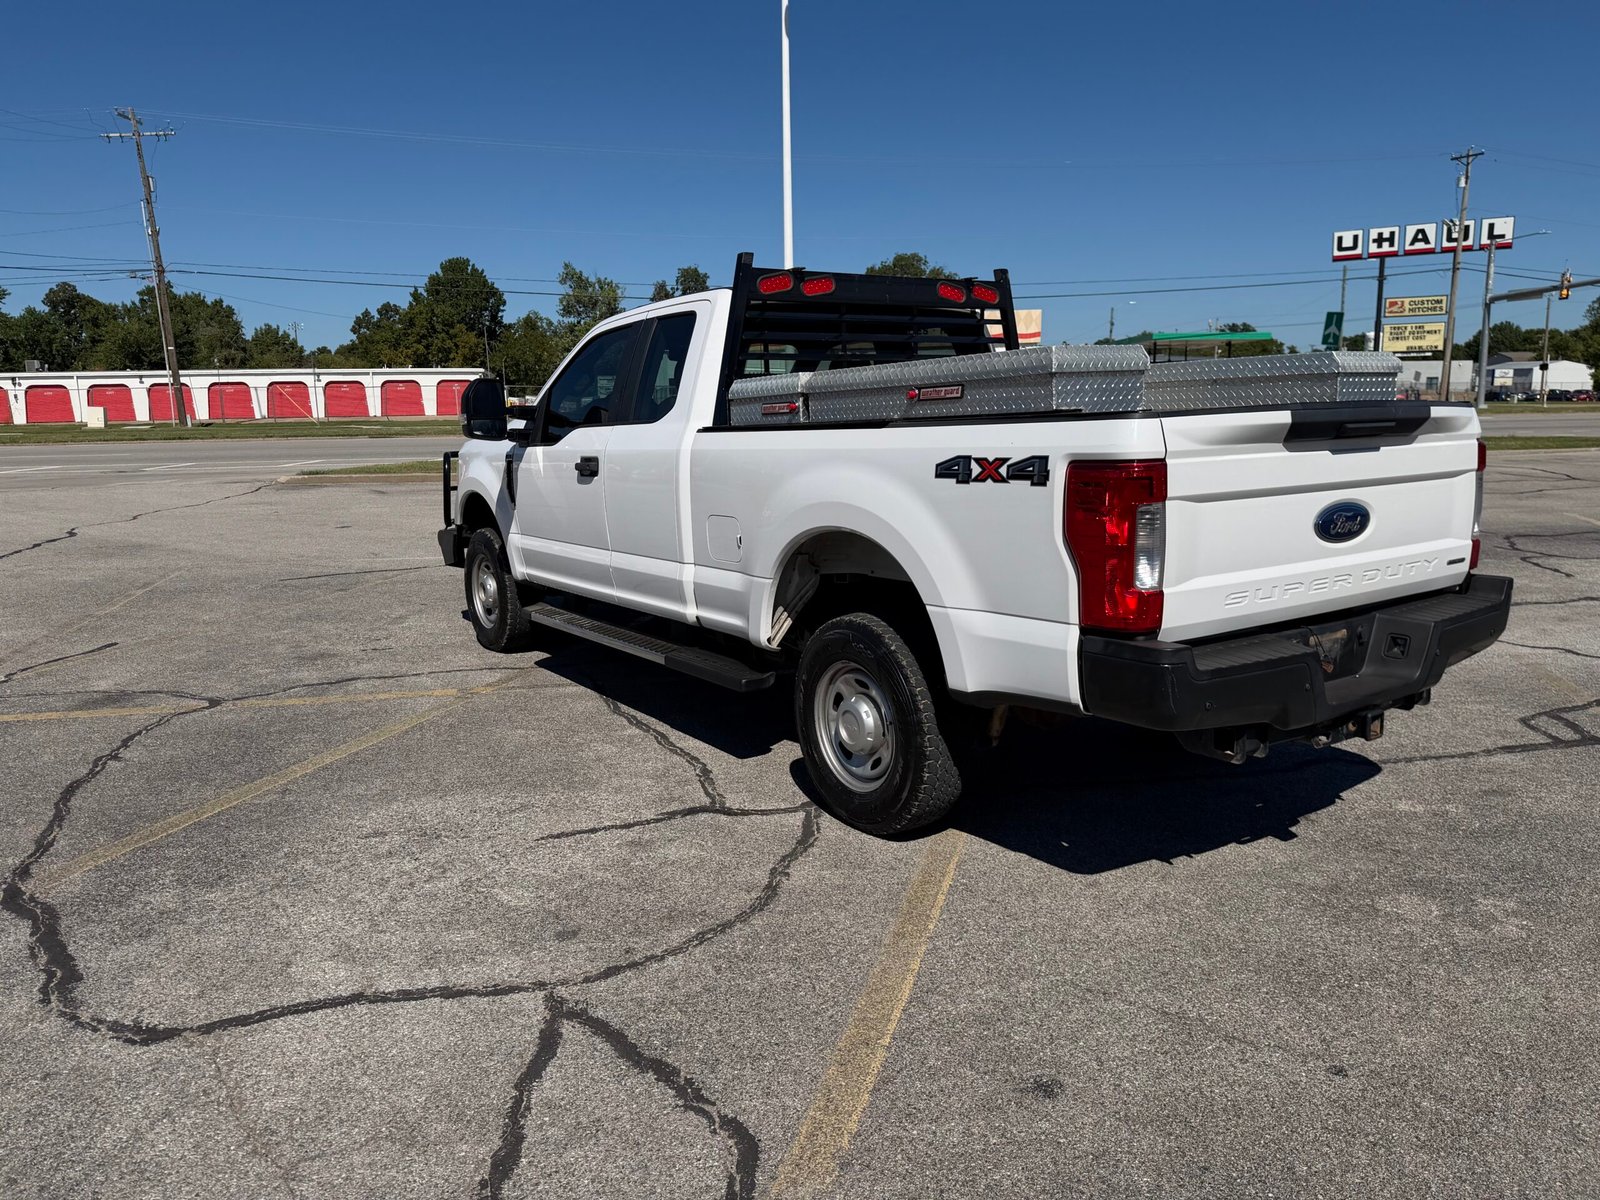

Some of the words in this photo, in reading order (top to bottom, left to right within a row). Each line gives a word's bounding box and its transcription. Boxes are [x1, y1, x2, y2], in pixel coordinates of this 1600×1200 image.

[1337, 222, 1506, 252] UHAUL
[1408, 299, 1443, 307] CUSTOM
[1330, 511, 1361, 535] Ford
[1224, 573, 1353, 608] SUPER
[1362, 557, 1439, 585] DUTY
